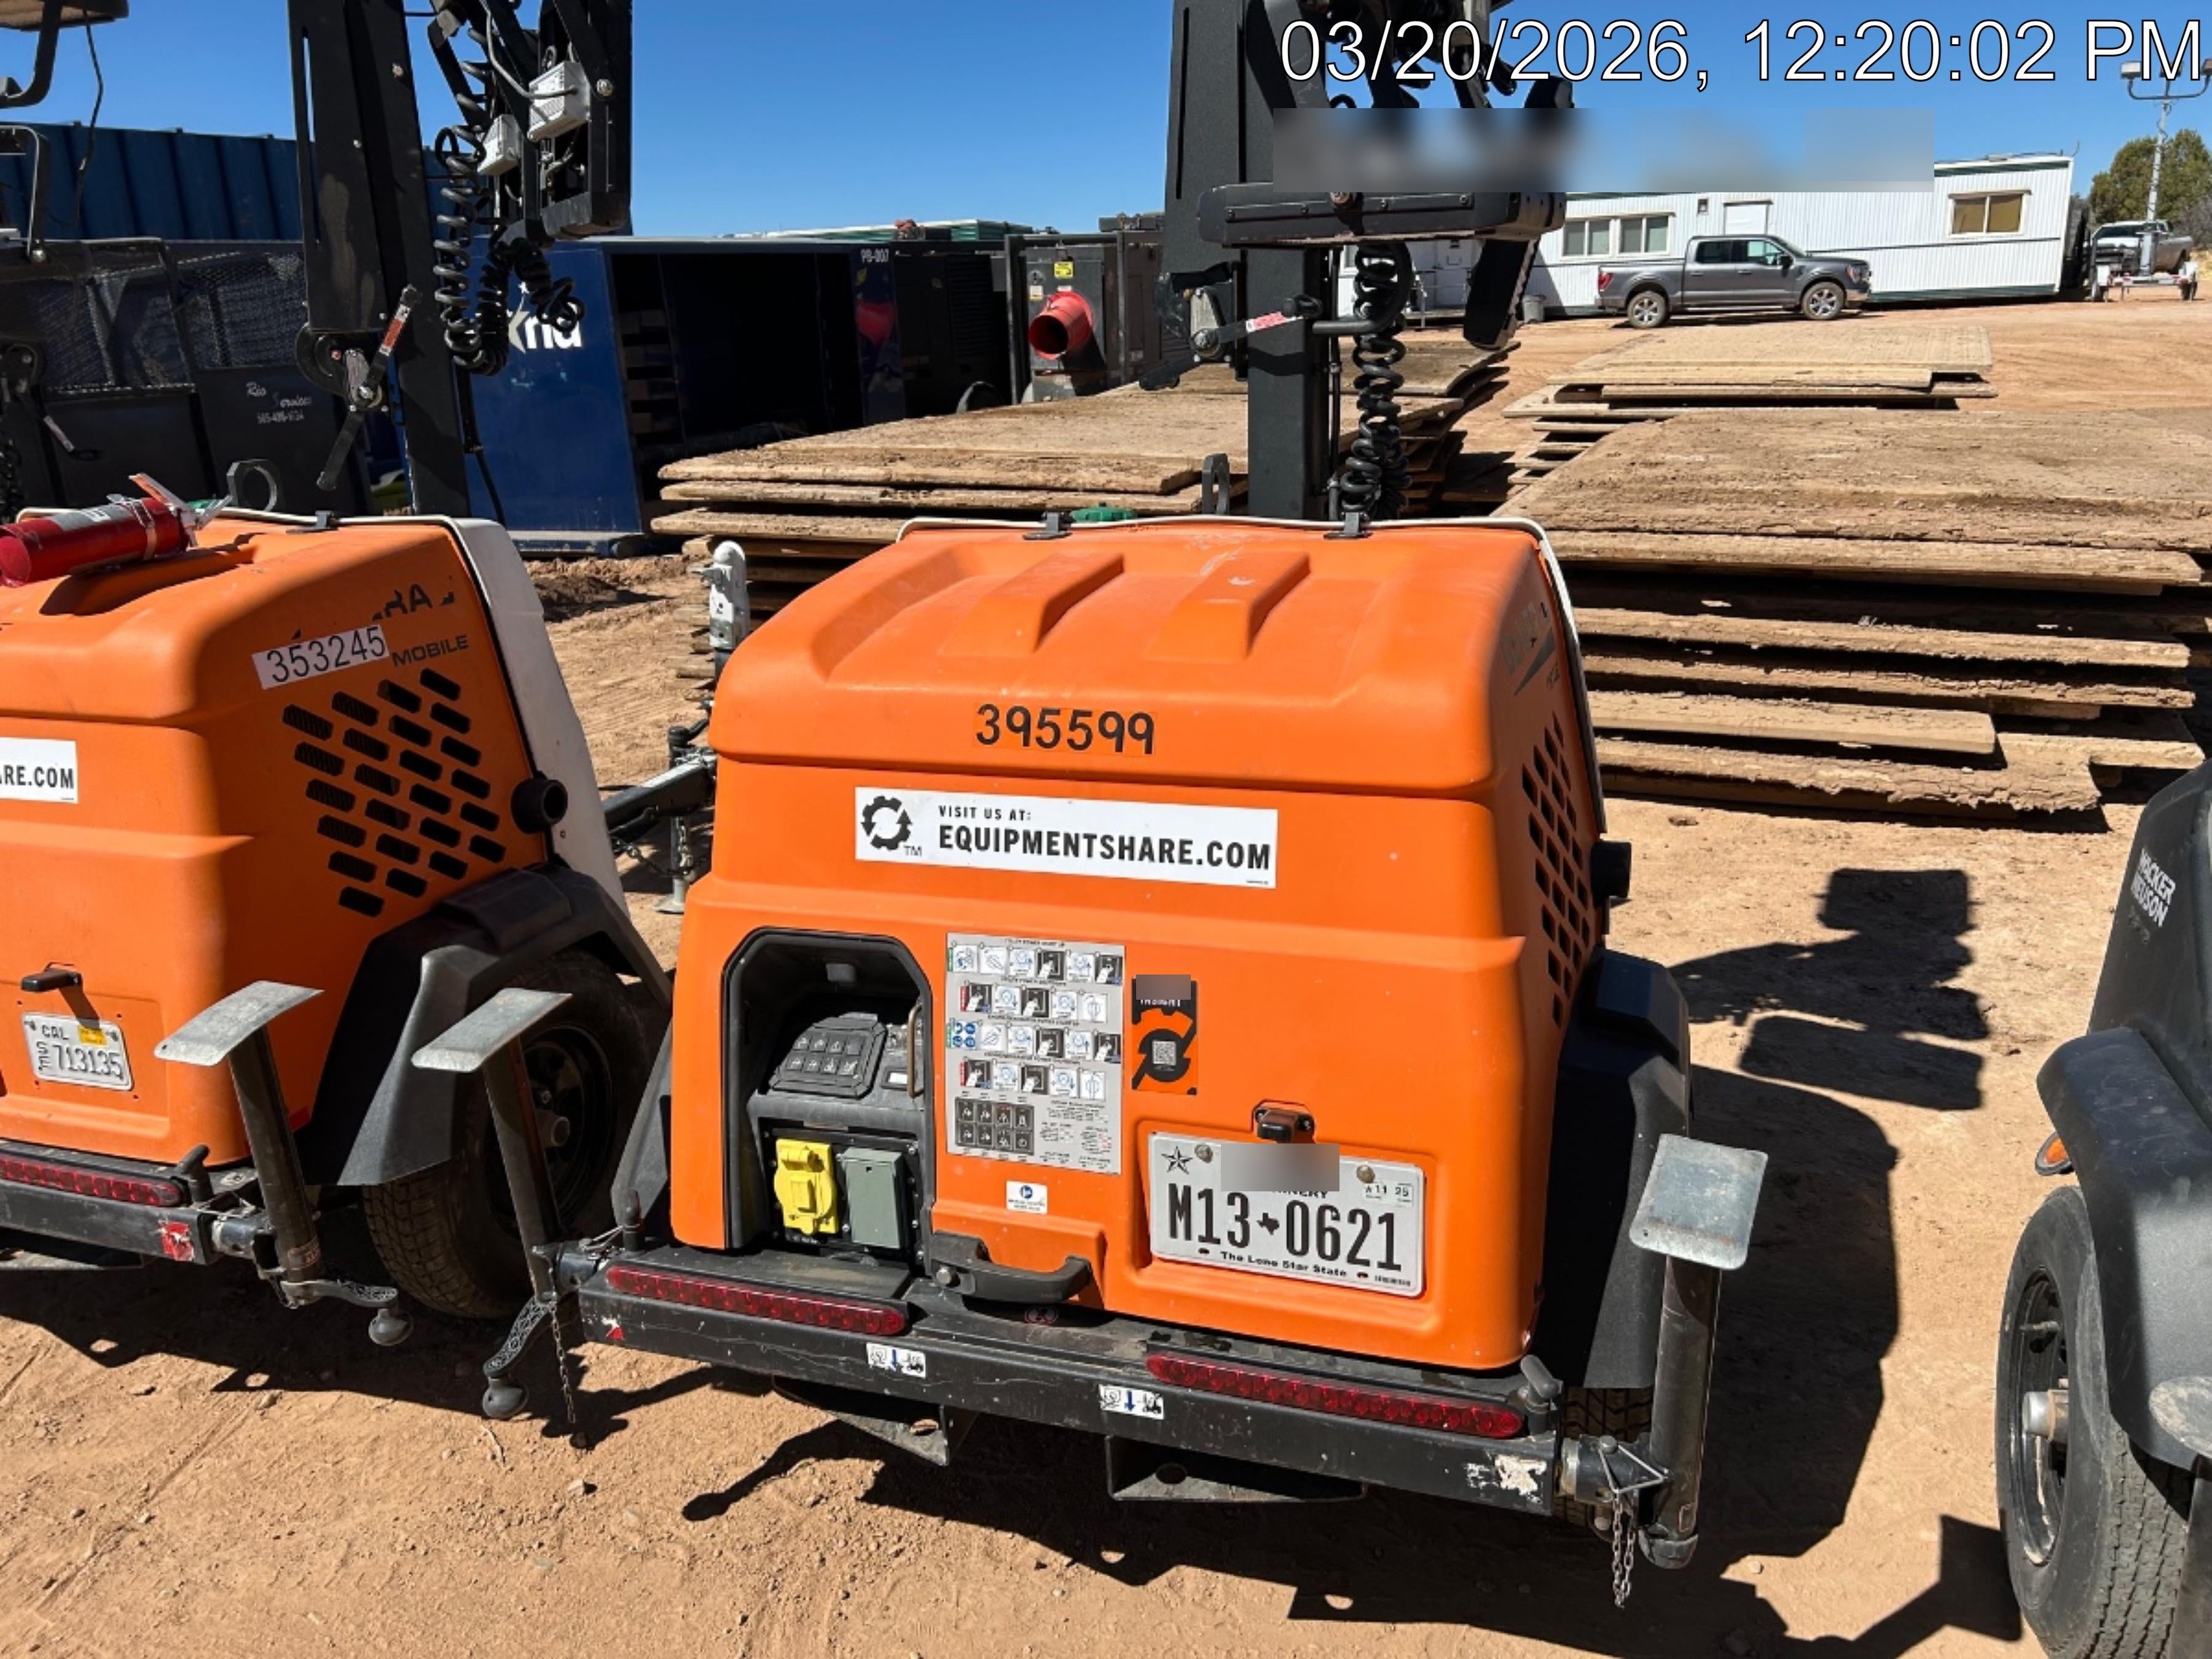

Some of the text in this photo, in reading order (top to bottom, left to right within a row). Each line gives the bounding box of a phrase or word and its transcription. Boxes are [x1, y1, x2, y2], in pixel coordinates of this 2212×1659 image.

[266, 626, 386, 683] 353245
[392, 635, 469, 667] MOBILE
[976, 704, 1155, 755] 395599
[0, 764, 74, 790] RE.COM
[938, 806, 1031, 821] VISIT US AT:
[939, 825, 1270, 870] EQUIPMENTSHARE.COM
[41, 1024, 70, 1040] CAL
[52, 1044, 123, 1078] 713135
[1168, 1183, 1402, 1272] M13 0621
[1220, 1251, 1347, 1277] The Lone Star State
